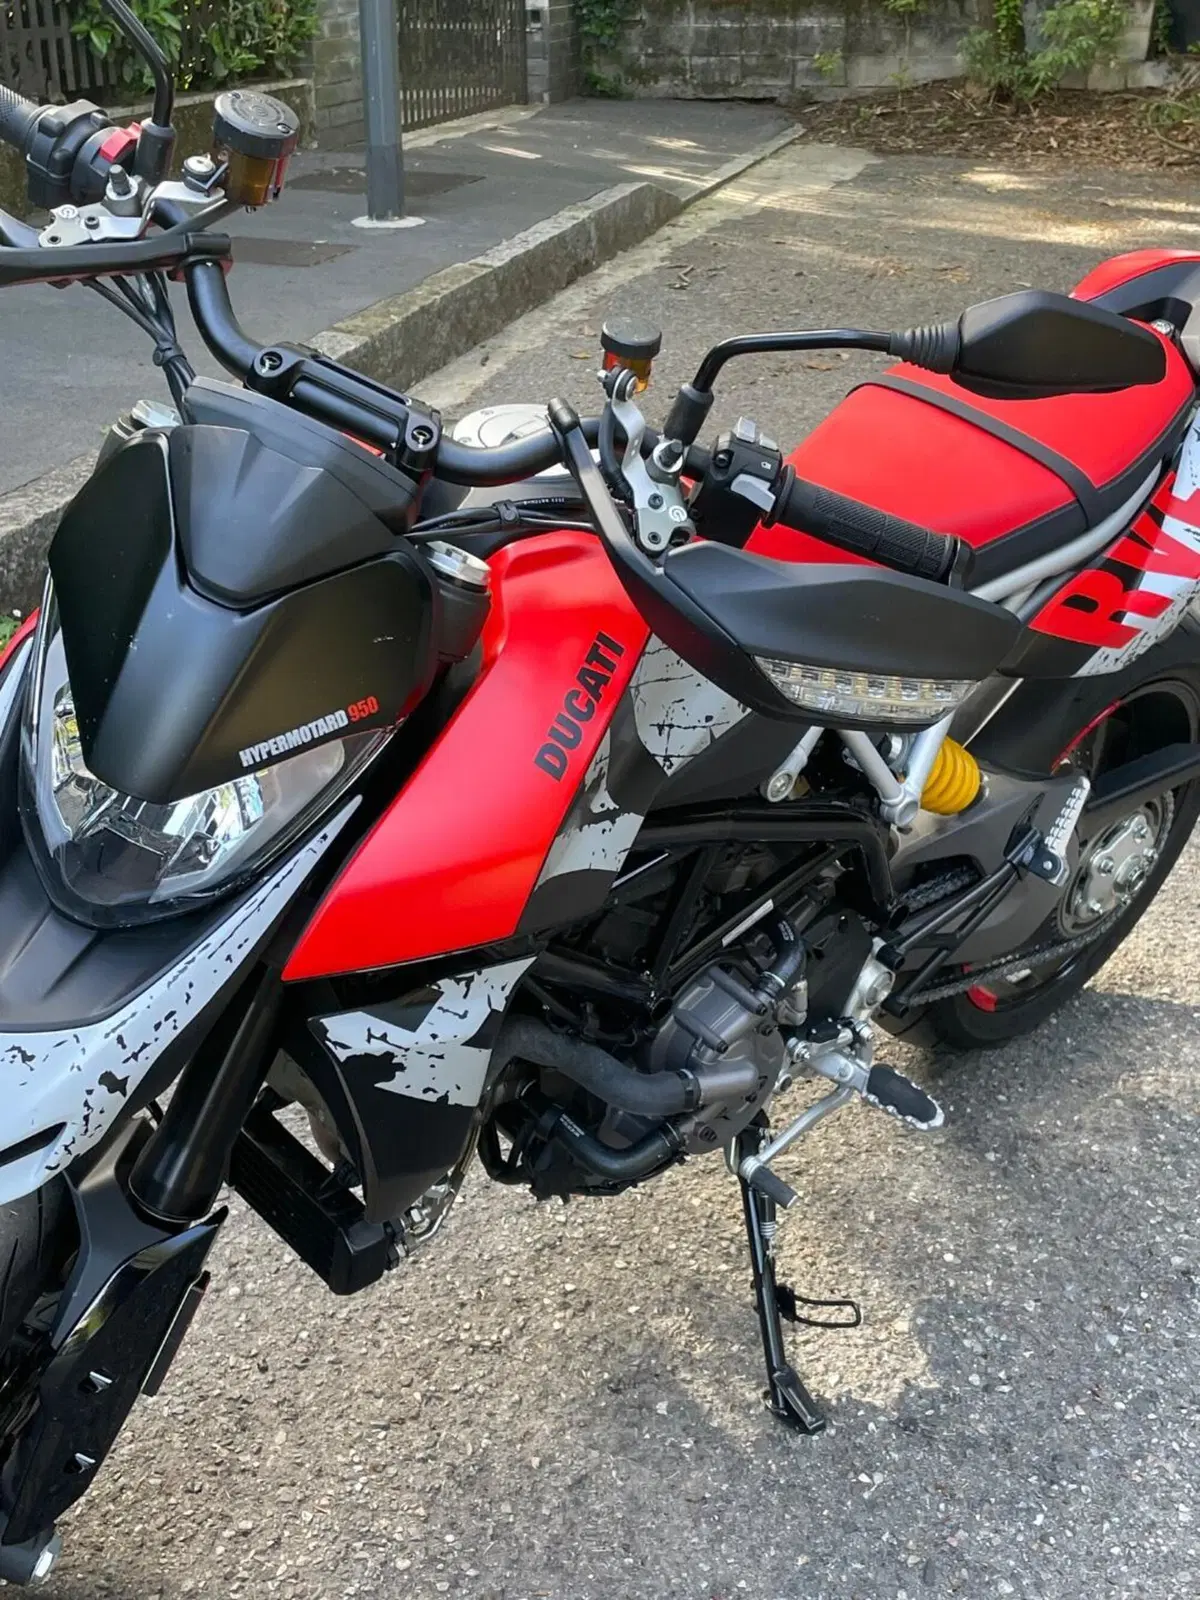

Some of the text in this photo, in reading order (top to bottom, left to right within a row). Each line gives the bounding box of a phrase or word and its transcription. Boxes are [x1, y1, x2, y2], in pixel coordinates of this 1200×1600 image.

[238, 696, 379, 768] HYPERMOTARD 950
[534, 630, 625, 782] DUCATI
